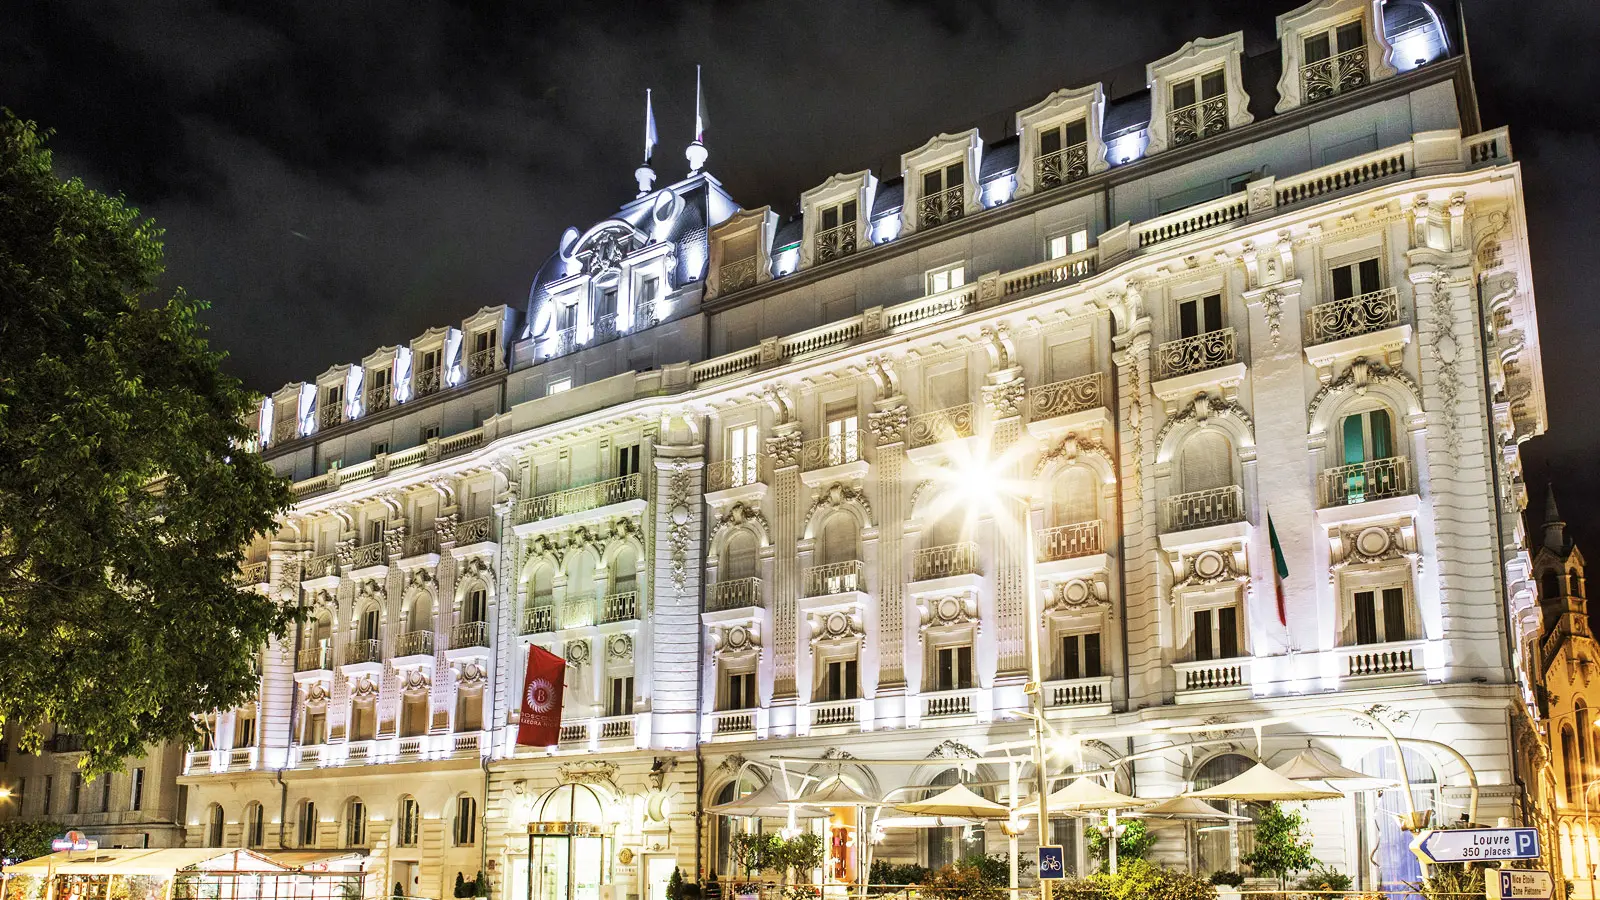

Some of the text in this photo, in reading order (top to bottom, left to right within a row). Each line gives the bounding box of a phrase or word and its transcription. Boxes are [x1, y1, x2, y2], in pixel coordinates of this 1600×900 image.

[1473, 834, 1532, 853] Louvre P
[1462, 847, 1511, 858] 350 places
[1512, 875, 1522, 884] Nice
[1513, 886, 1523, 896] Zone
